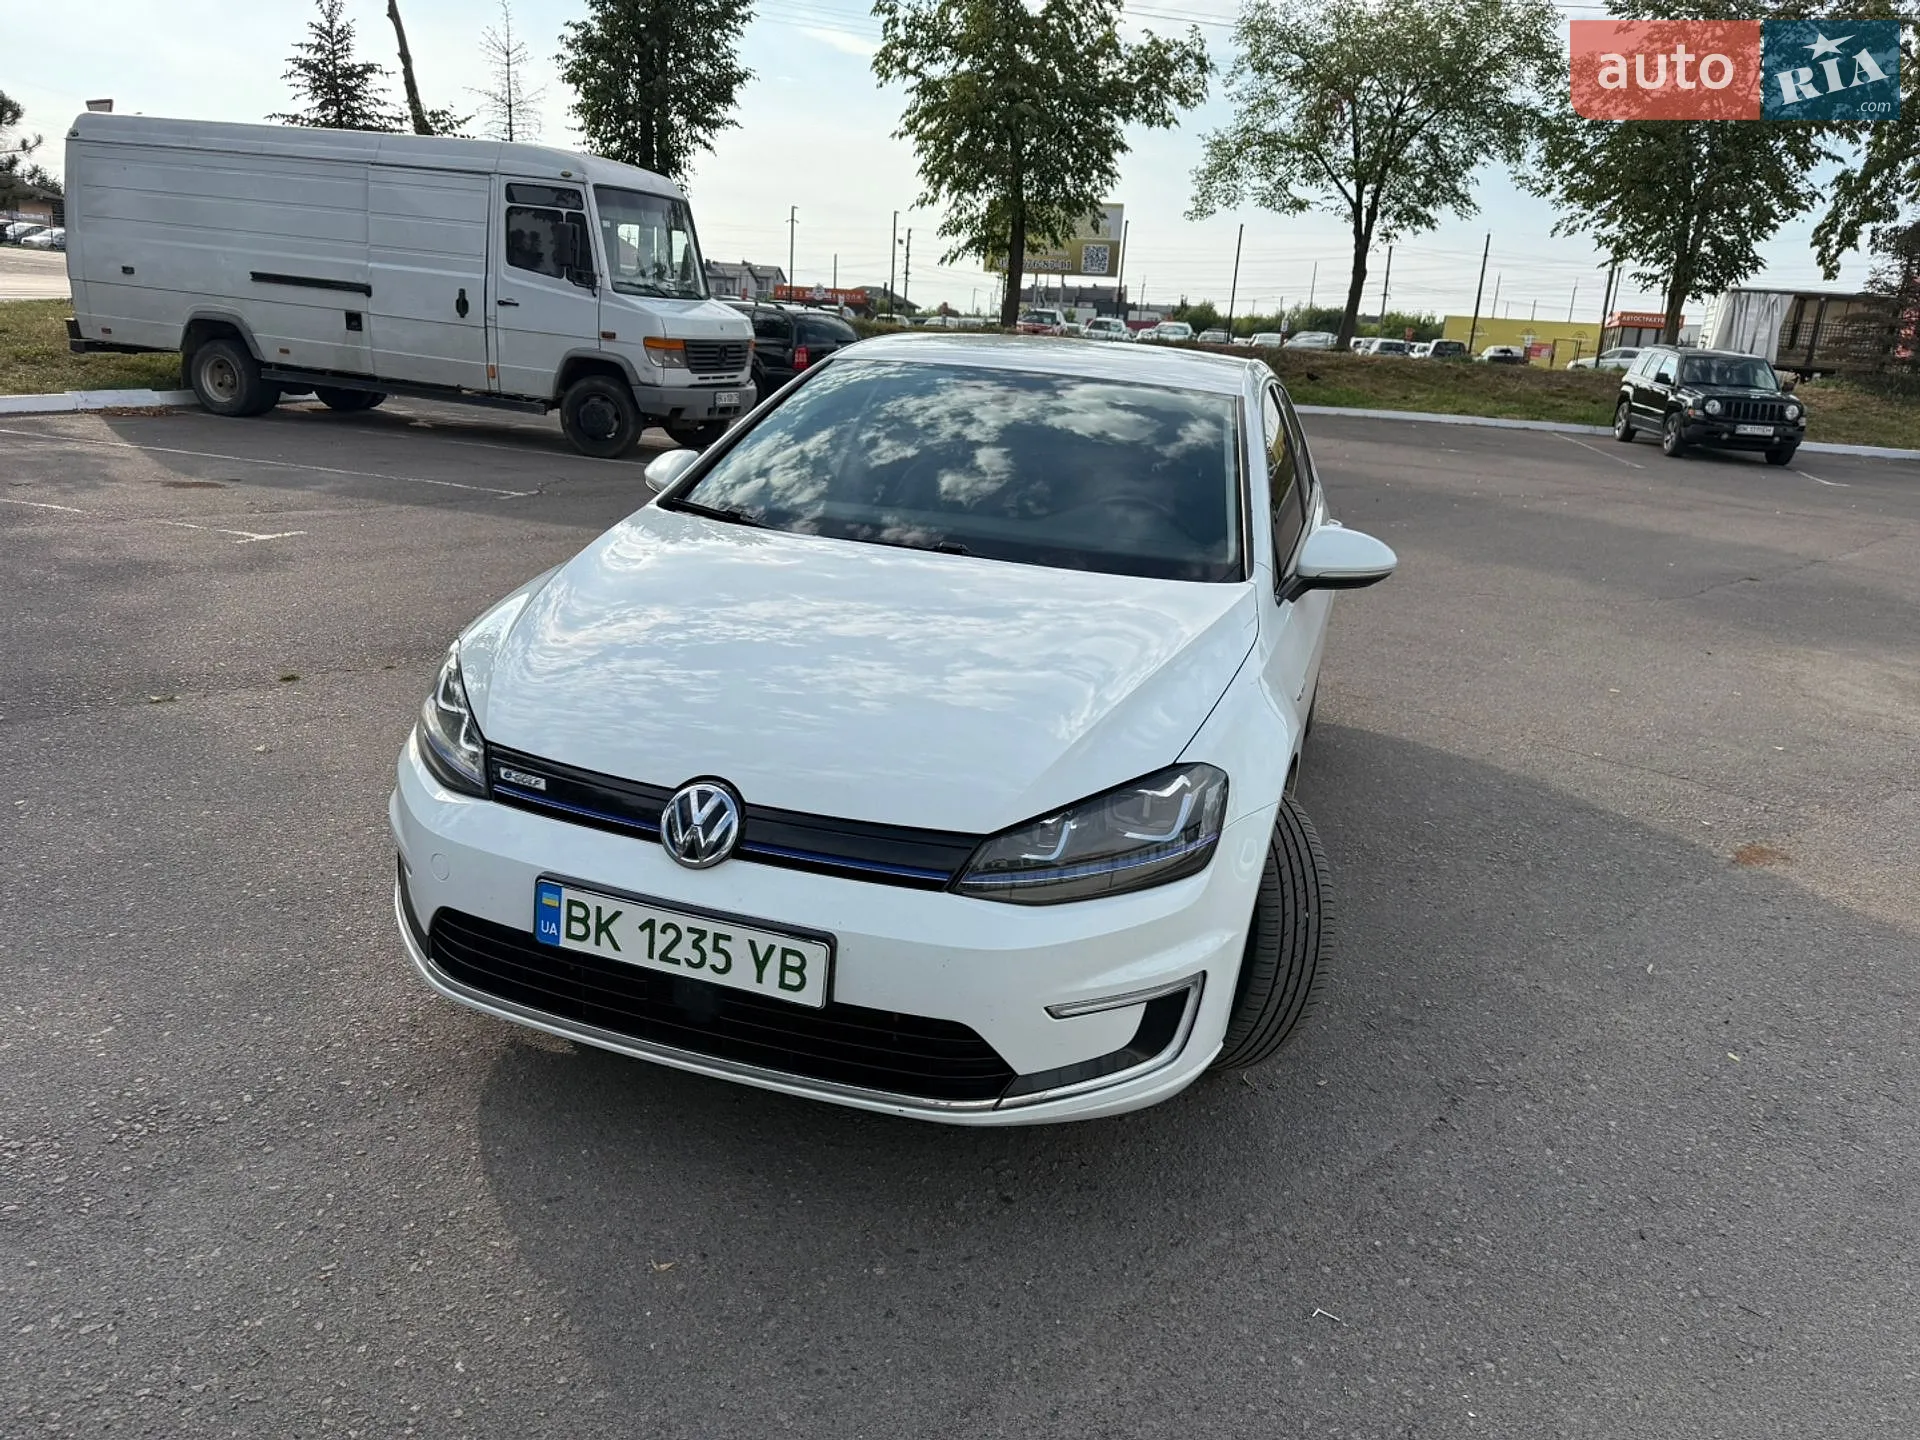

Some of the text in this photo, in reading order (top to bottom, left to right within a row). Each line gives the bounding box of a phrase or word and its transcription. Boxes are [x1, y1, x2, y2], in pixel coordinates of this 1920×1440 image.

[541, 920, 558, 936] UA
[565, 899, 807, 992] BK 1235 YB
